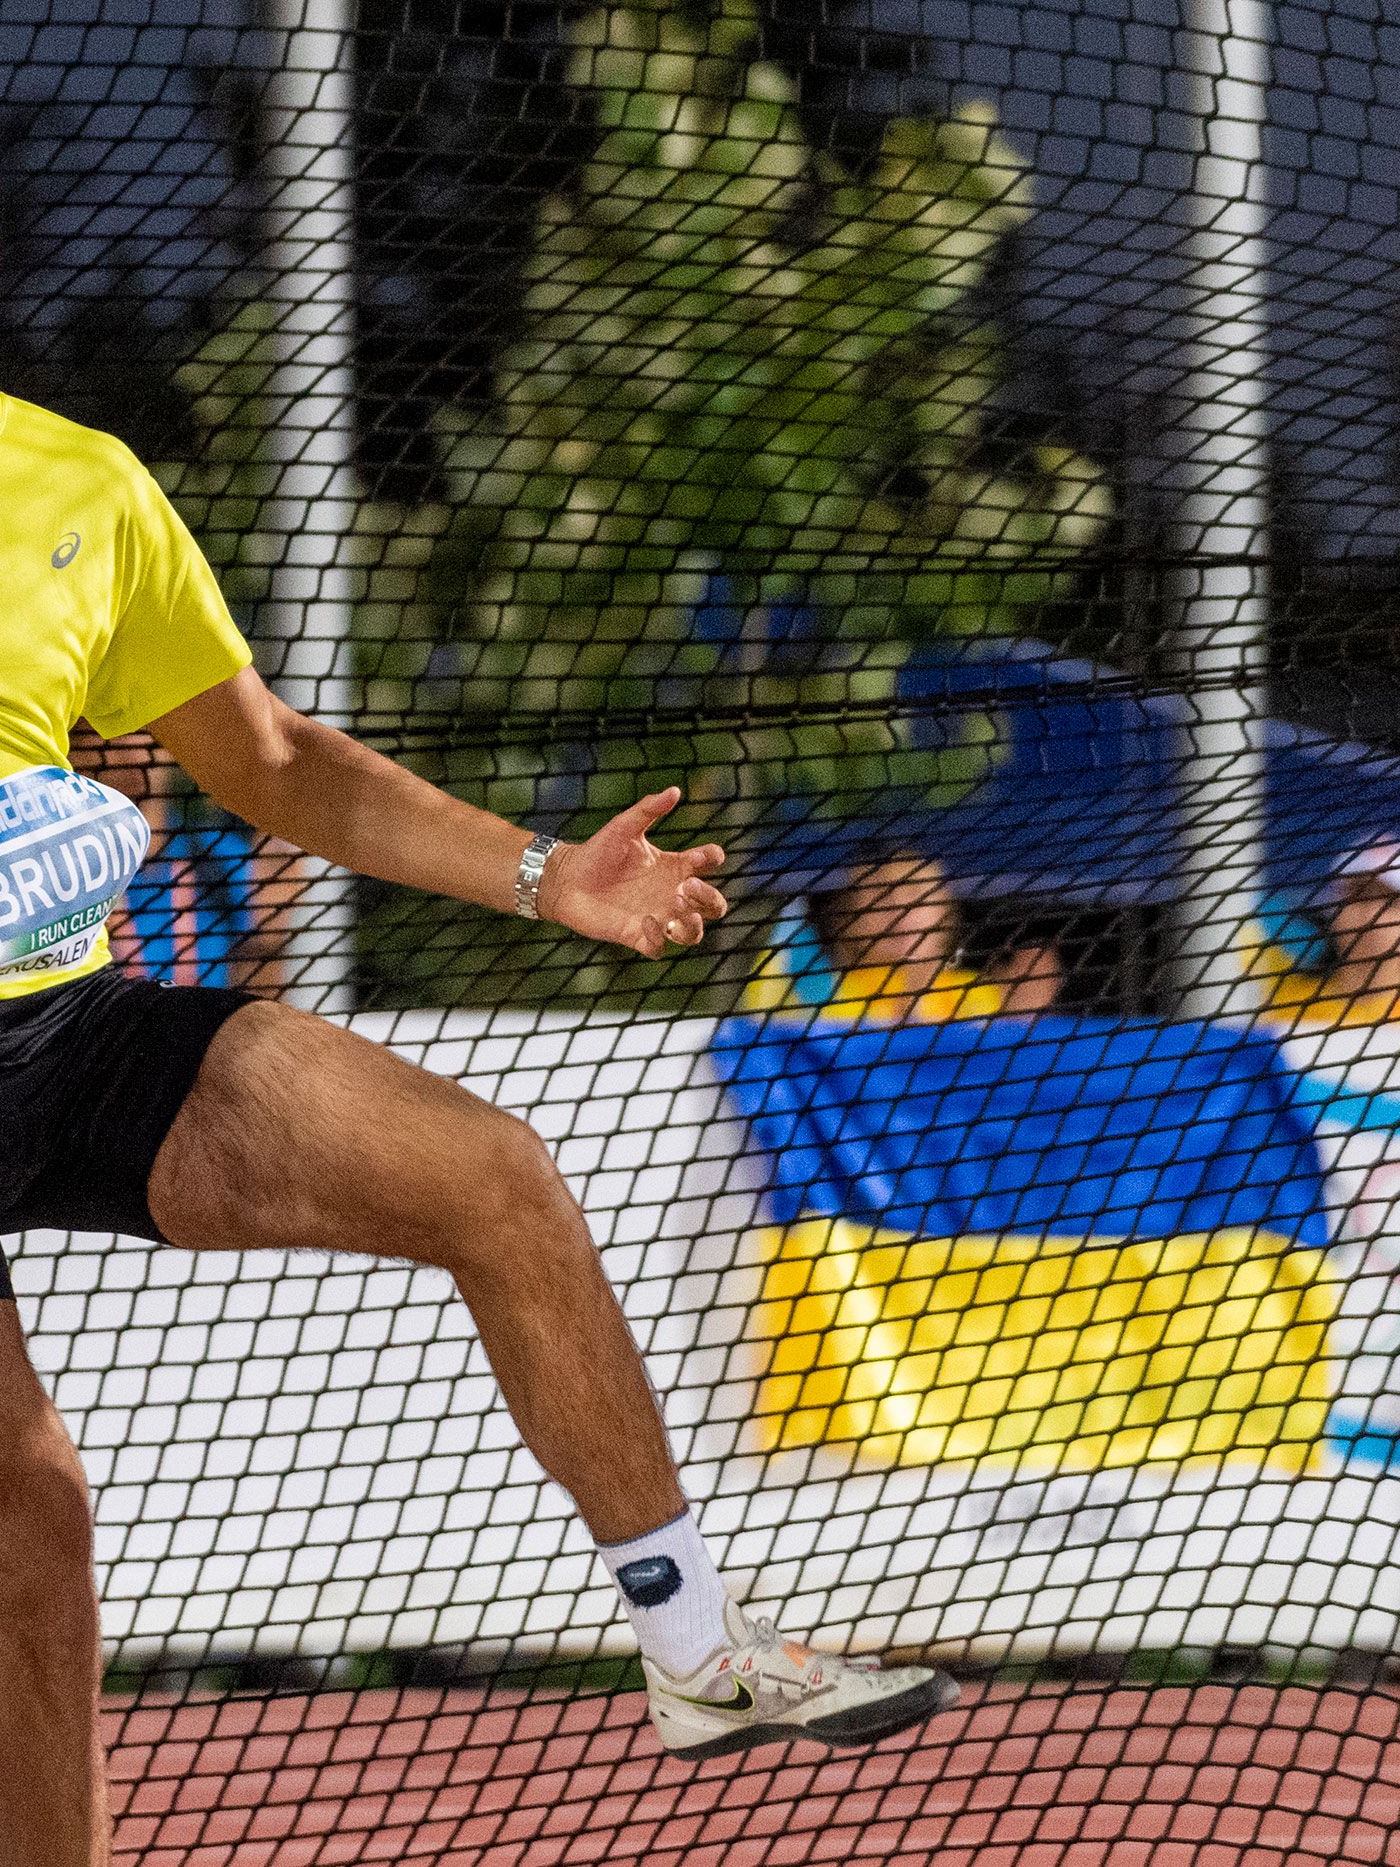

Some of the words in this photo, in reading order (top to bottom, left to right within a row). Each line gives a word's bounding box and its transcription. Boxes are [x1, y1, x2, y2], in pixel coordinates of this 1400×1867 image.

[30, 933, 36, 950] I
[38, 919, 68, 947] RUN
[70, 898, 113, 932] CLEAN
